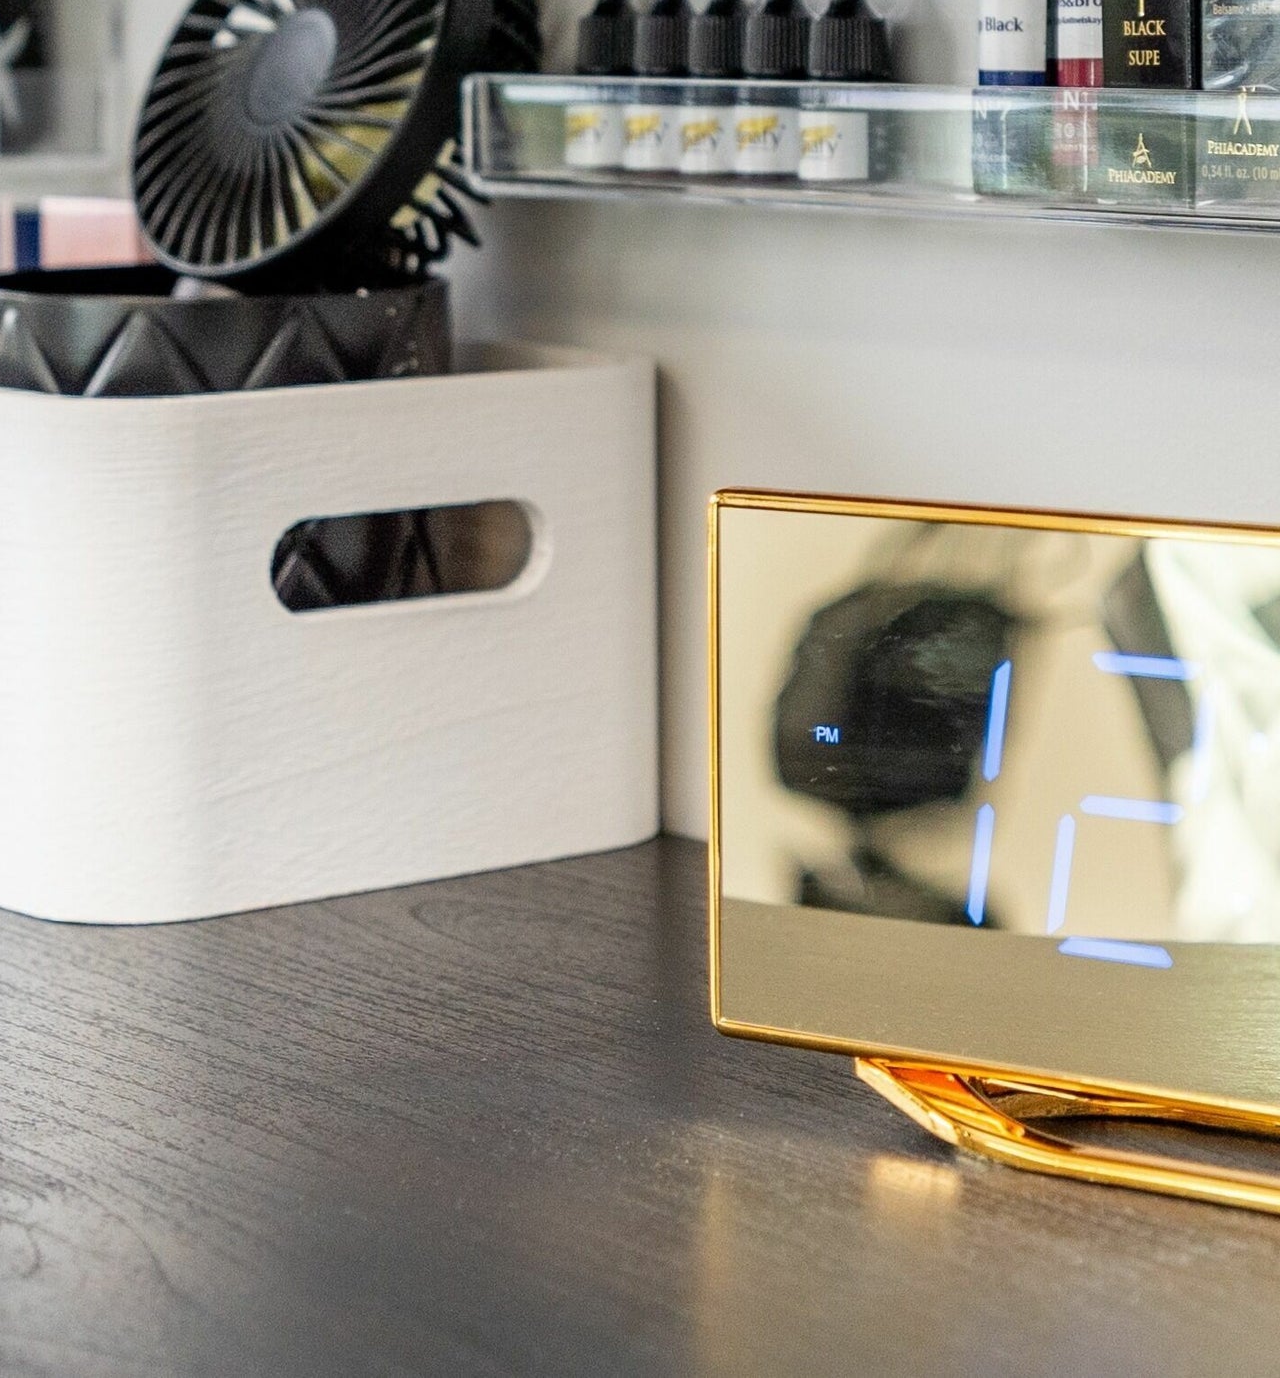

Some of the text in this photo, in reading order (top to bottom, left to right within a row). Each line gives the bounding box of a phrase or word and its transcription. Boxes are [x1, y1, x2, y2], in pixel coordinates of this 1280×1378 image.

[985, 16, 1023, 33] Black
[1123, 20, 1166, 37] BLACK
[1129, 50, 1161, 66] SUPE
[1207, 139, 1280, 157] PHIACADEMY
[1108, 168, 1177, 185] PHIACADEMY
[816, 725, 839, 744] PM
